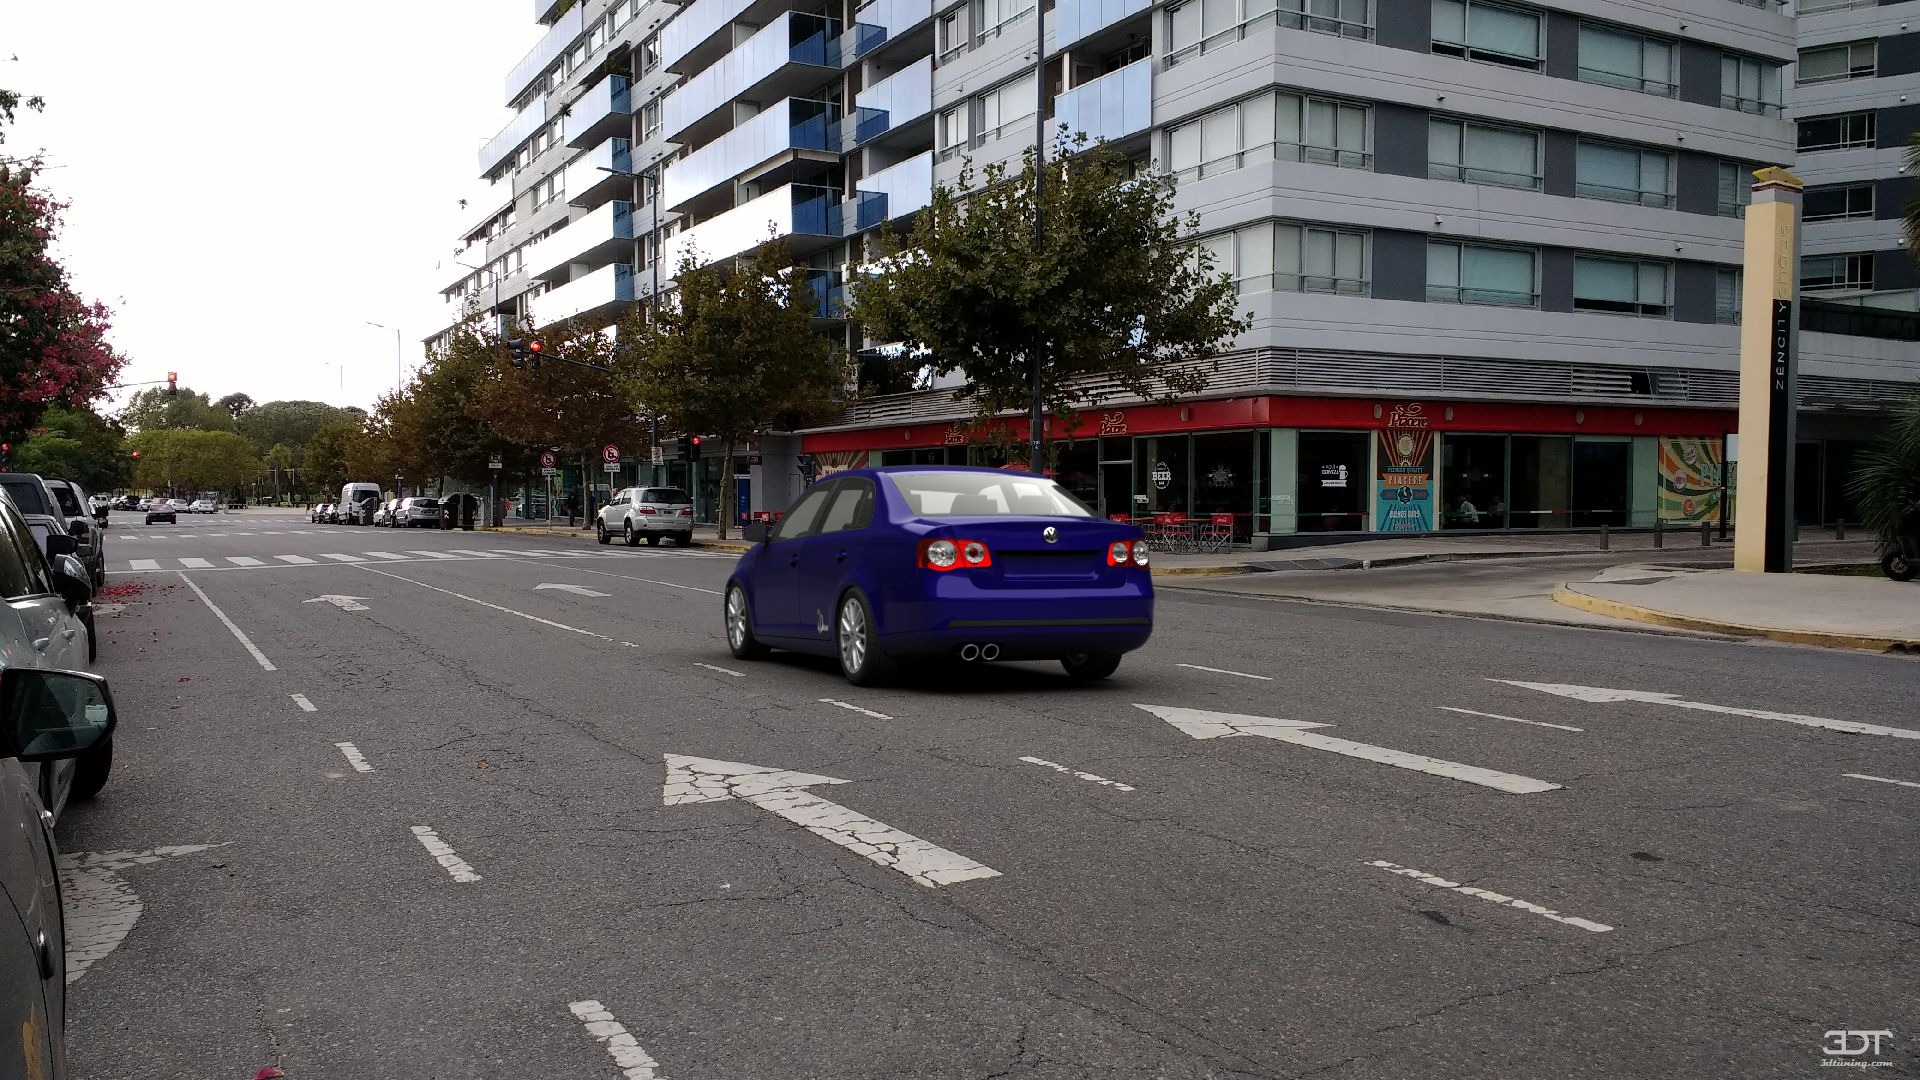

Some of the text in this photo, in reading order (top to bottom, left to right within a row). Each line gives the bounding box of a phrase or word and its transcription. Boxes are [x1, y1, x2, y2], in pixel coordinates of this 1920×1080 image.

[1775, 301, 1787, 390] ZENCITY
[1151, 471, 1171, 481] BEER
[1388, 475, 1423, 485] PIACERE
